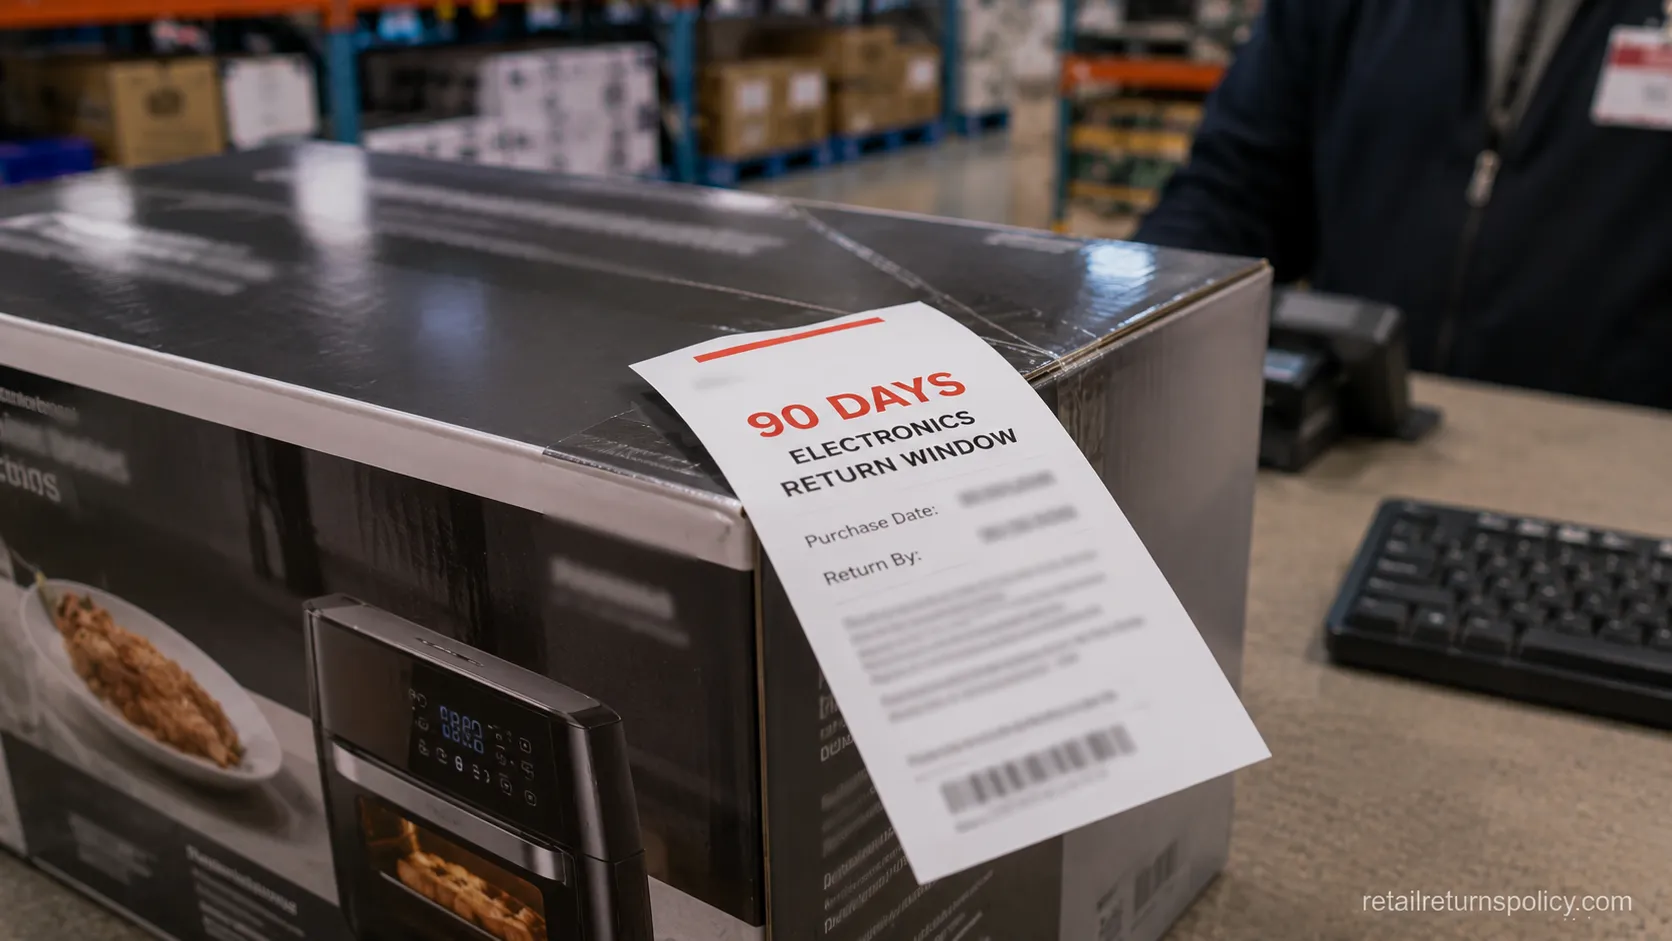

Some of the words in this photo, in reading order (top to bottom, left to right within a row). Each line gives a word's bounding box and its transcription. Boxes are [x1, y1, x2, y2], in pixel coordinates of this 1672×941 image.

[747, 404, 819, 438] 90
[826, 372, 966, 421] DAYS
[780, 456, 899, 498] RETURN
[899, 427, 1018, 468] WINDOW
[788, 410, 976, 465] ELECTRONICS
[804, 518, 890, 549] Purchase
[890, 504, 939, 526] Date:
[822, 559, 889, 586] Return
[889, 549, 923, 573] By:
